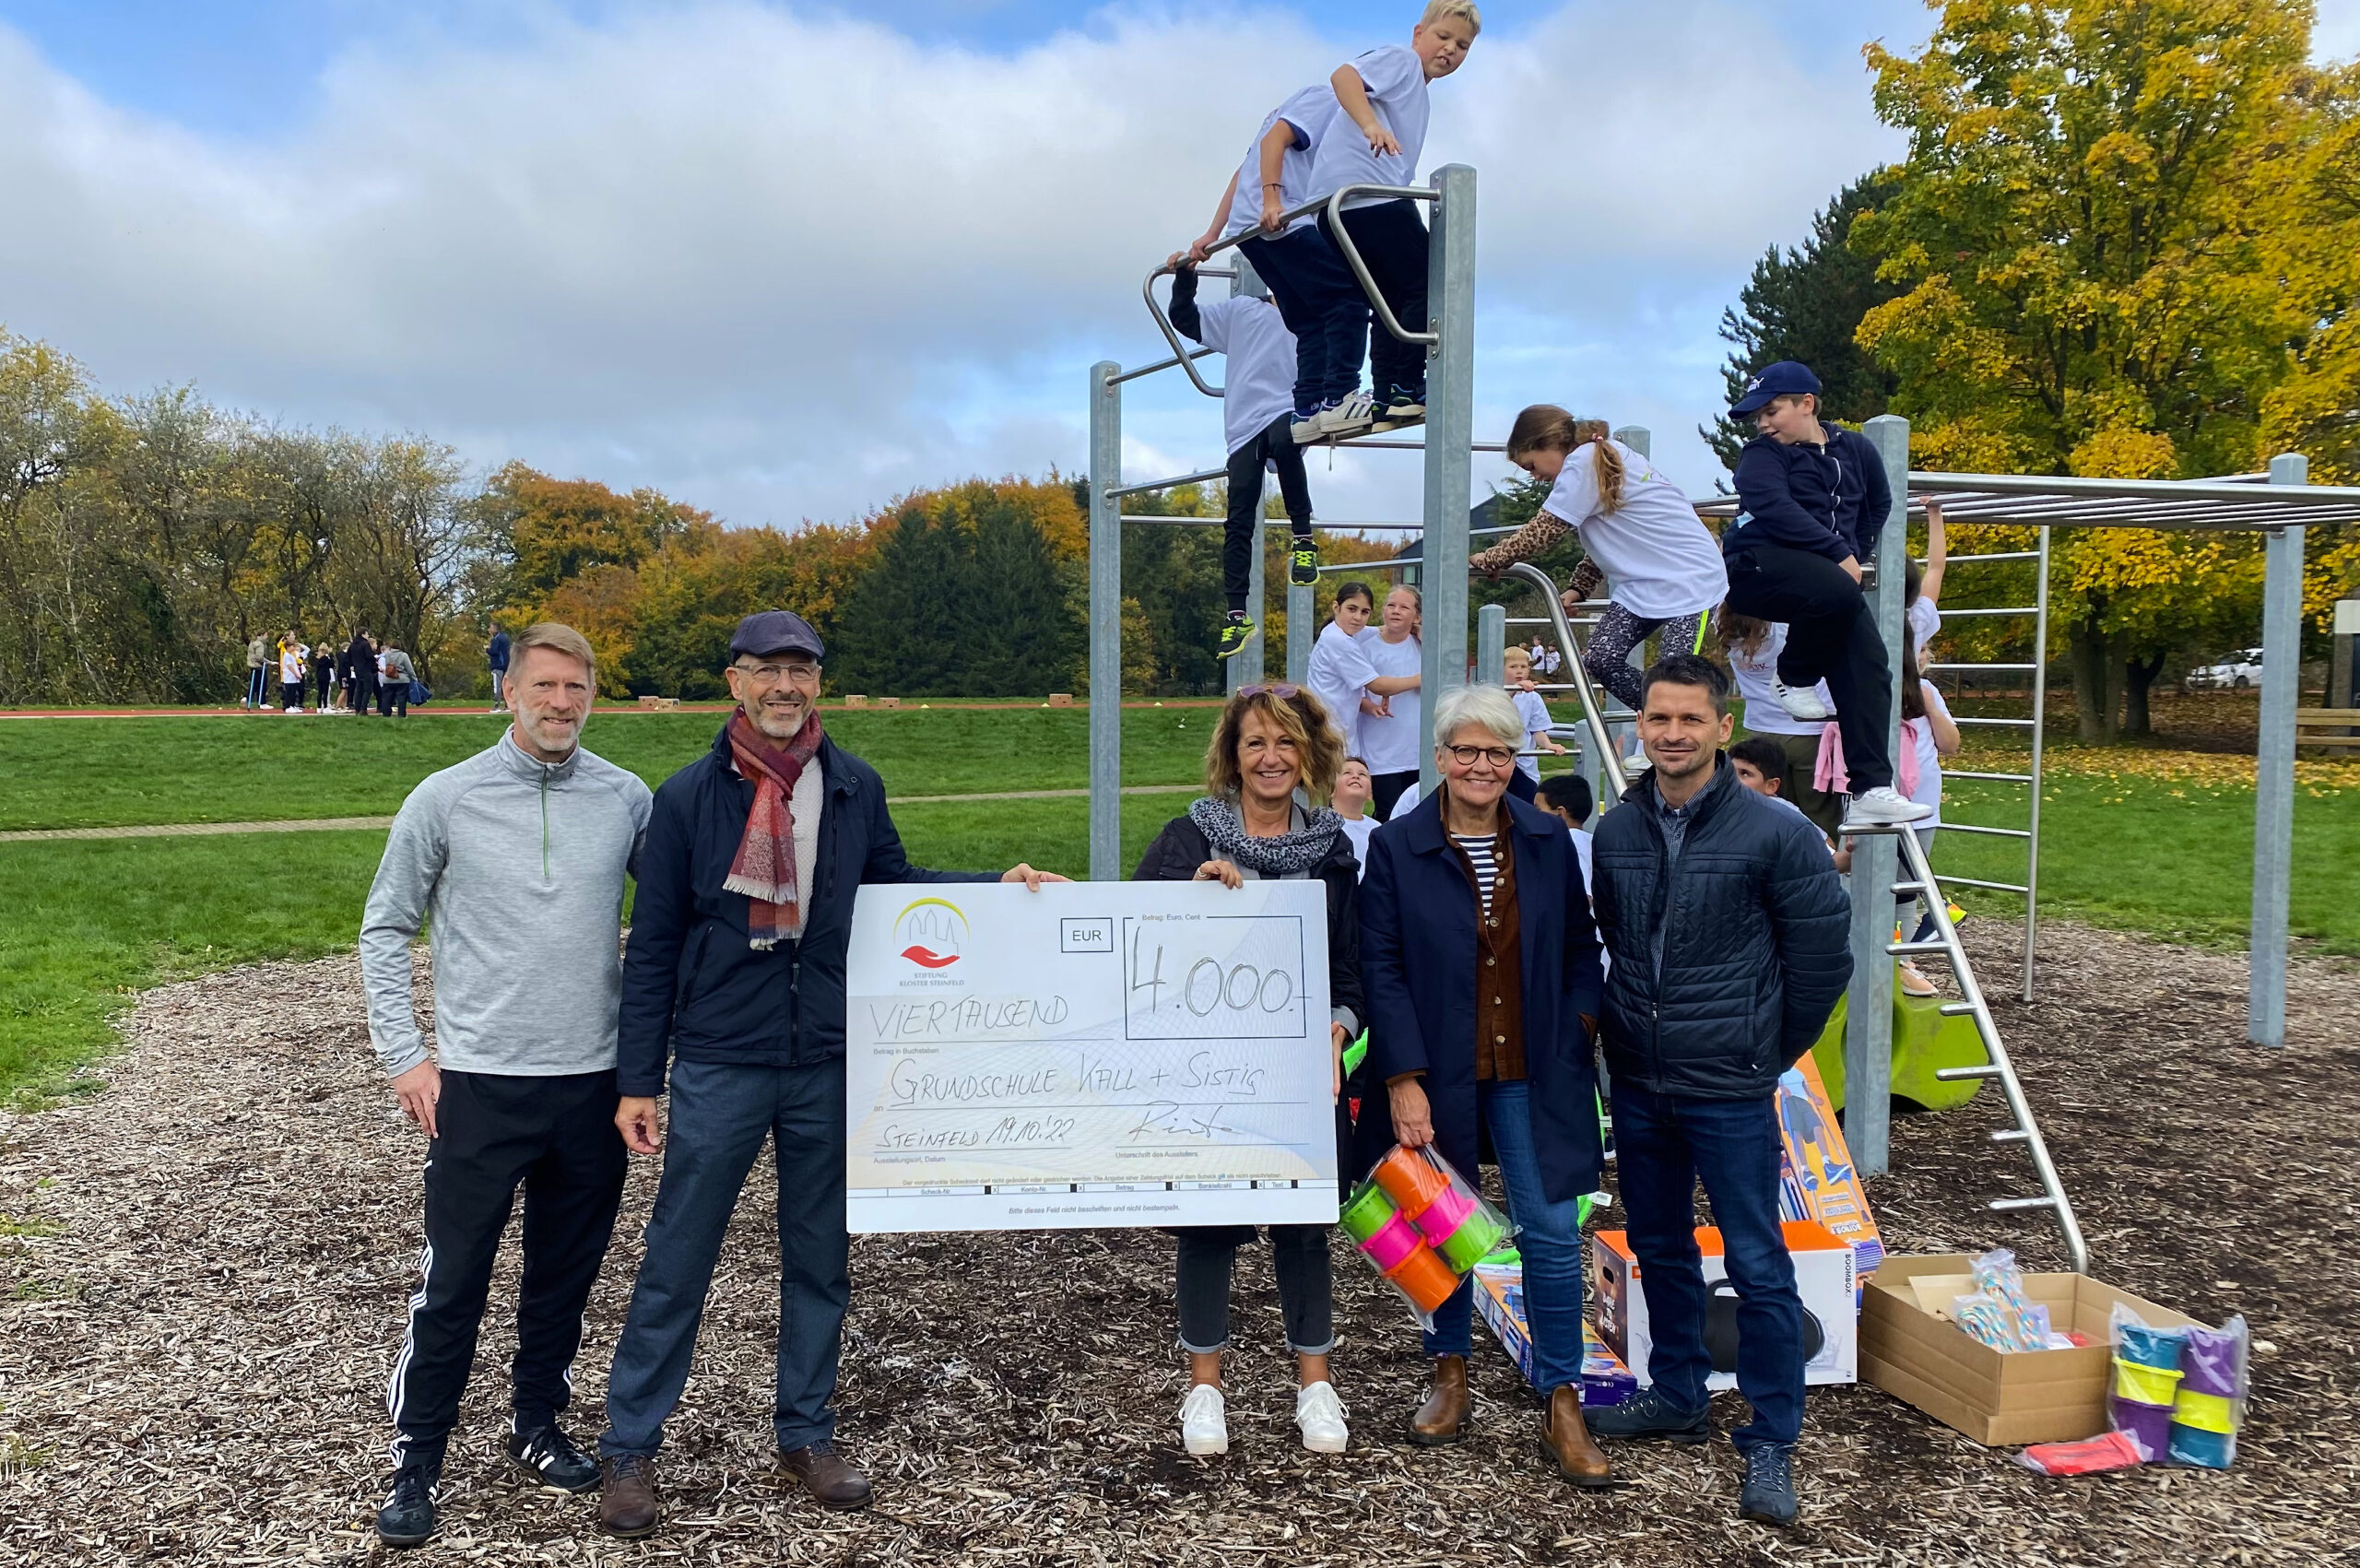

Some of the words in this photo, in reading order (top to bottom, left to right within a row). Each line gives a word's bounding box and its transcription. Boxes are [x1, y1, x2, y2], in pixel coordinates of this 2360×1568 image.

[1166, 914, 1184, 922] Euro,
[1072, 929, 1102, 942] EUR
[873, 1047, 894, 1055] Betrag
[1150, 1067, 1171, 1087] +
[1115, 1150, 1151, 1159] Unterschrift
[1115, 1184, 1135, 1192] Betrag
[1077, 1205, 1113, 1213] beschriften
[1126, 1204, 1142, 1212] nicht
[1142, 1204, 1181, 1212] bestempeln.
